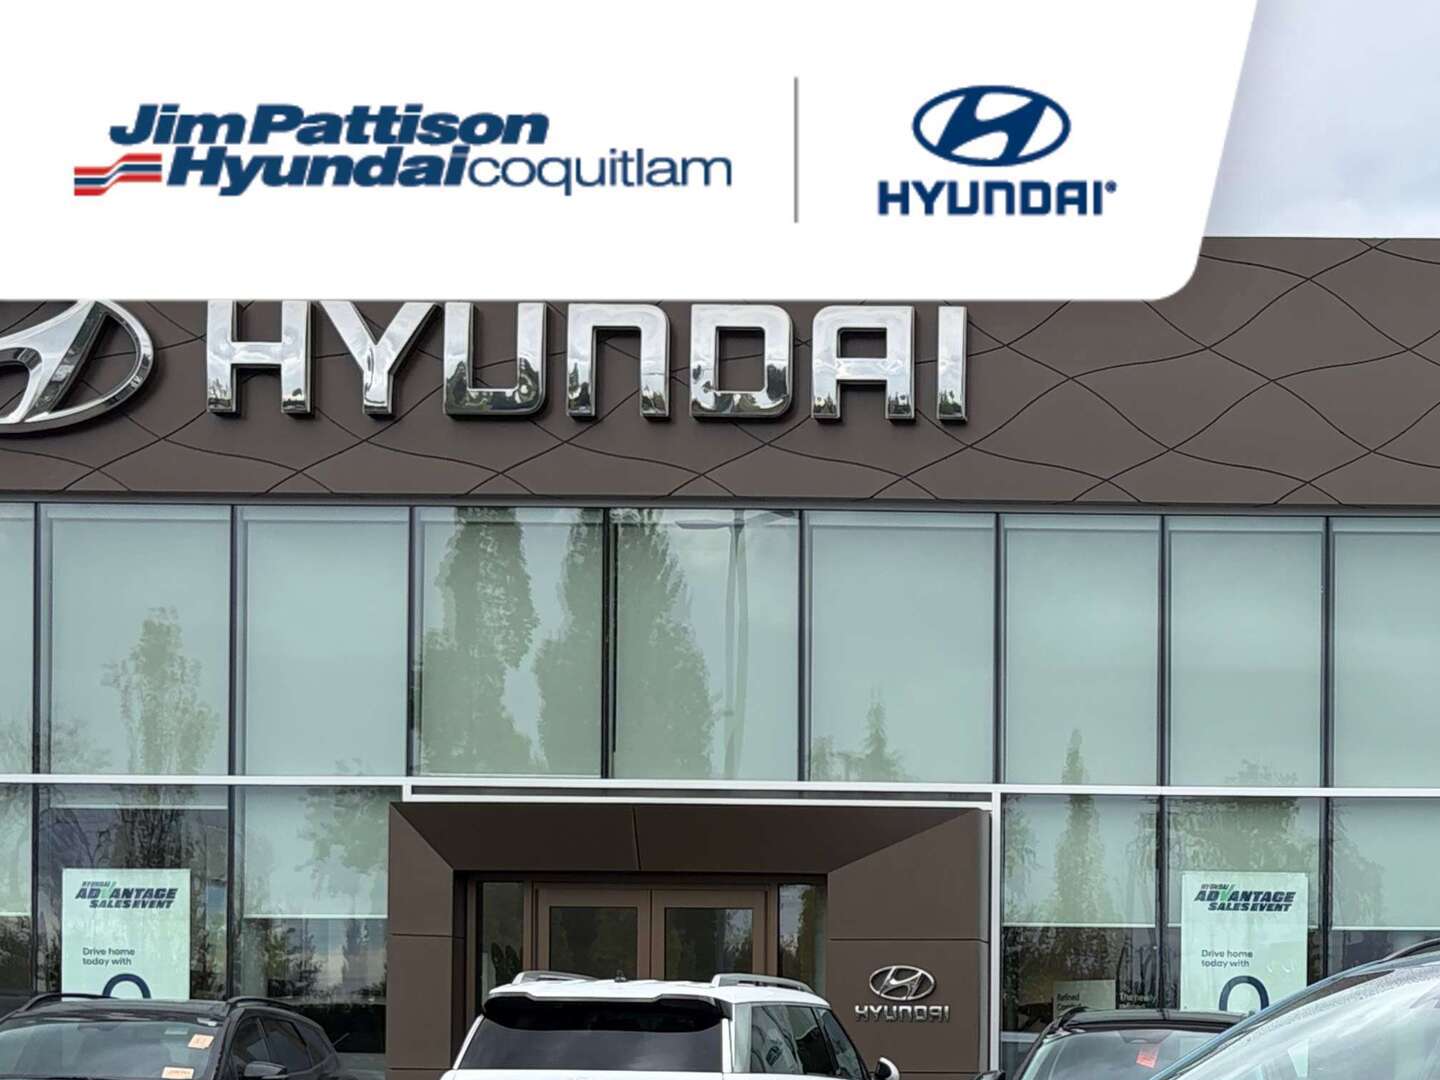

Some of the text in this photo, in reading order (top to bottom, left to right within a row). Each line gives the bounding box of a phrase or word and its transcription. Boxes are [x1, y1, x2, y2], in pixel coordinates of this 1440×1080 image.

[206, 300, 968, 422] HYUNDAI
[75, 887, 178, 899] ADVANTAGE
[1194, 889, 1296, 902] ADVANTAGE
[1201, 950, 1253, 958] Drive home
[82, 957, 109, 966] today
[1201, 960, 1227, 968] today
[854, 1005, 949, 1021] HYUNDAI
